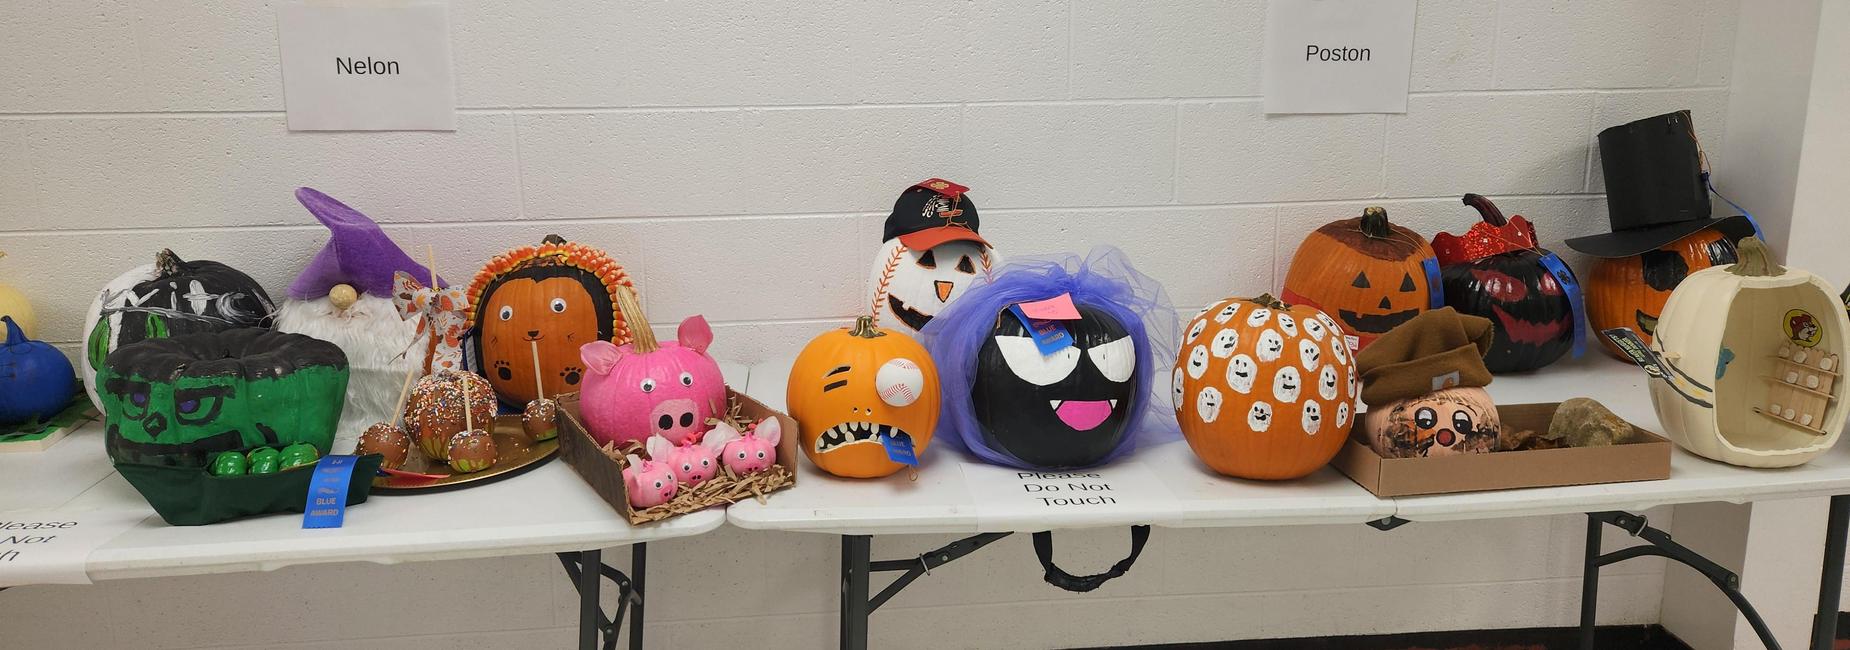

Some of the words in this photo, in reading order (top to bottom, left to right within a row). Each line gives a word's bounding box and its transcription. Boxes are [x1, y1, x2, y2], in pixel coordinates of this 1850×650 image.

[1306, 44, 1371, 62] Poston
[336, 56, 400, 75] Nelon
[1017, 472, 1101, 480] Please
[1023, 483, 1060, 493] Do
[1068, 483, 1115, 492] Not
[316, 497, 337, 505] BLUE
[1036, 495, 1117, 506] Touch
[0, 521, 78, 531] lease
